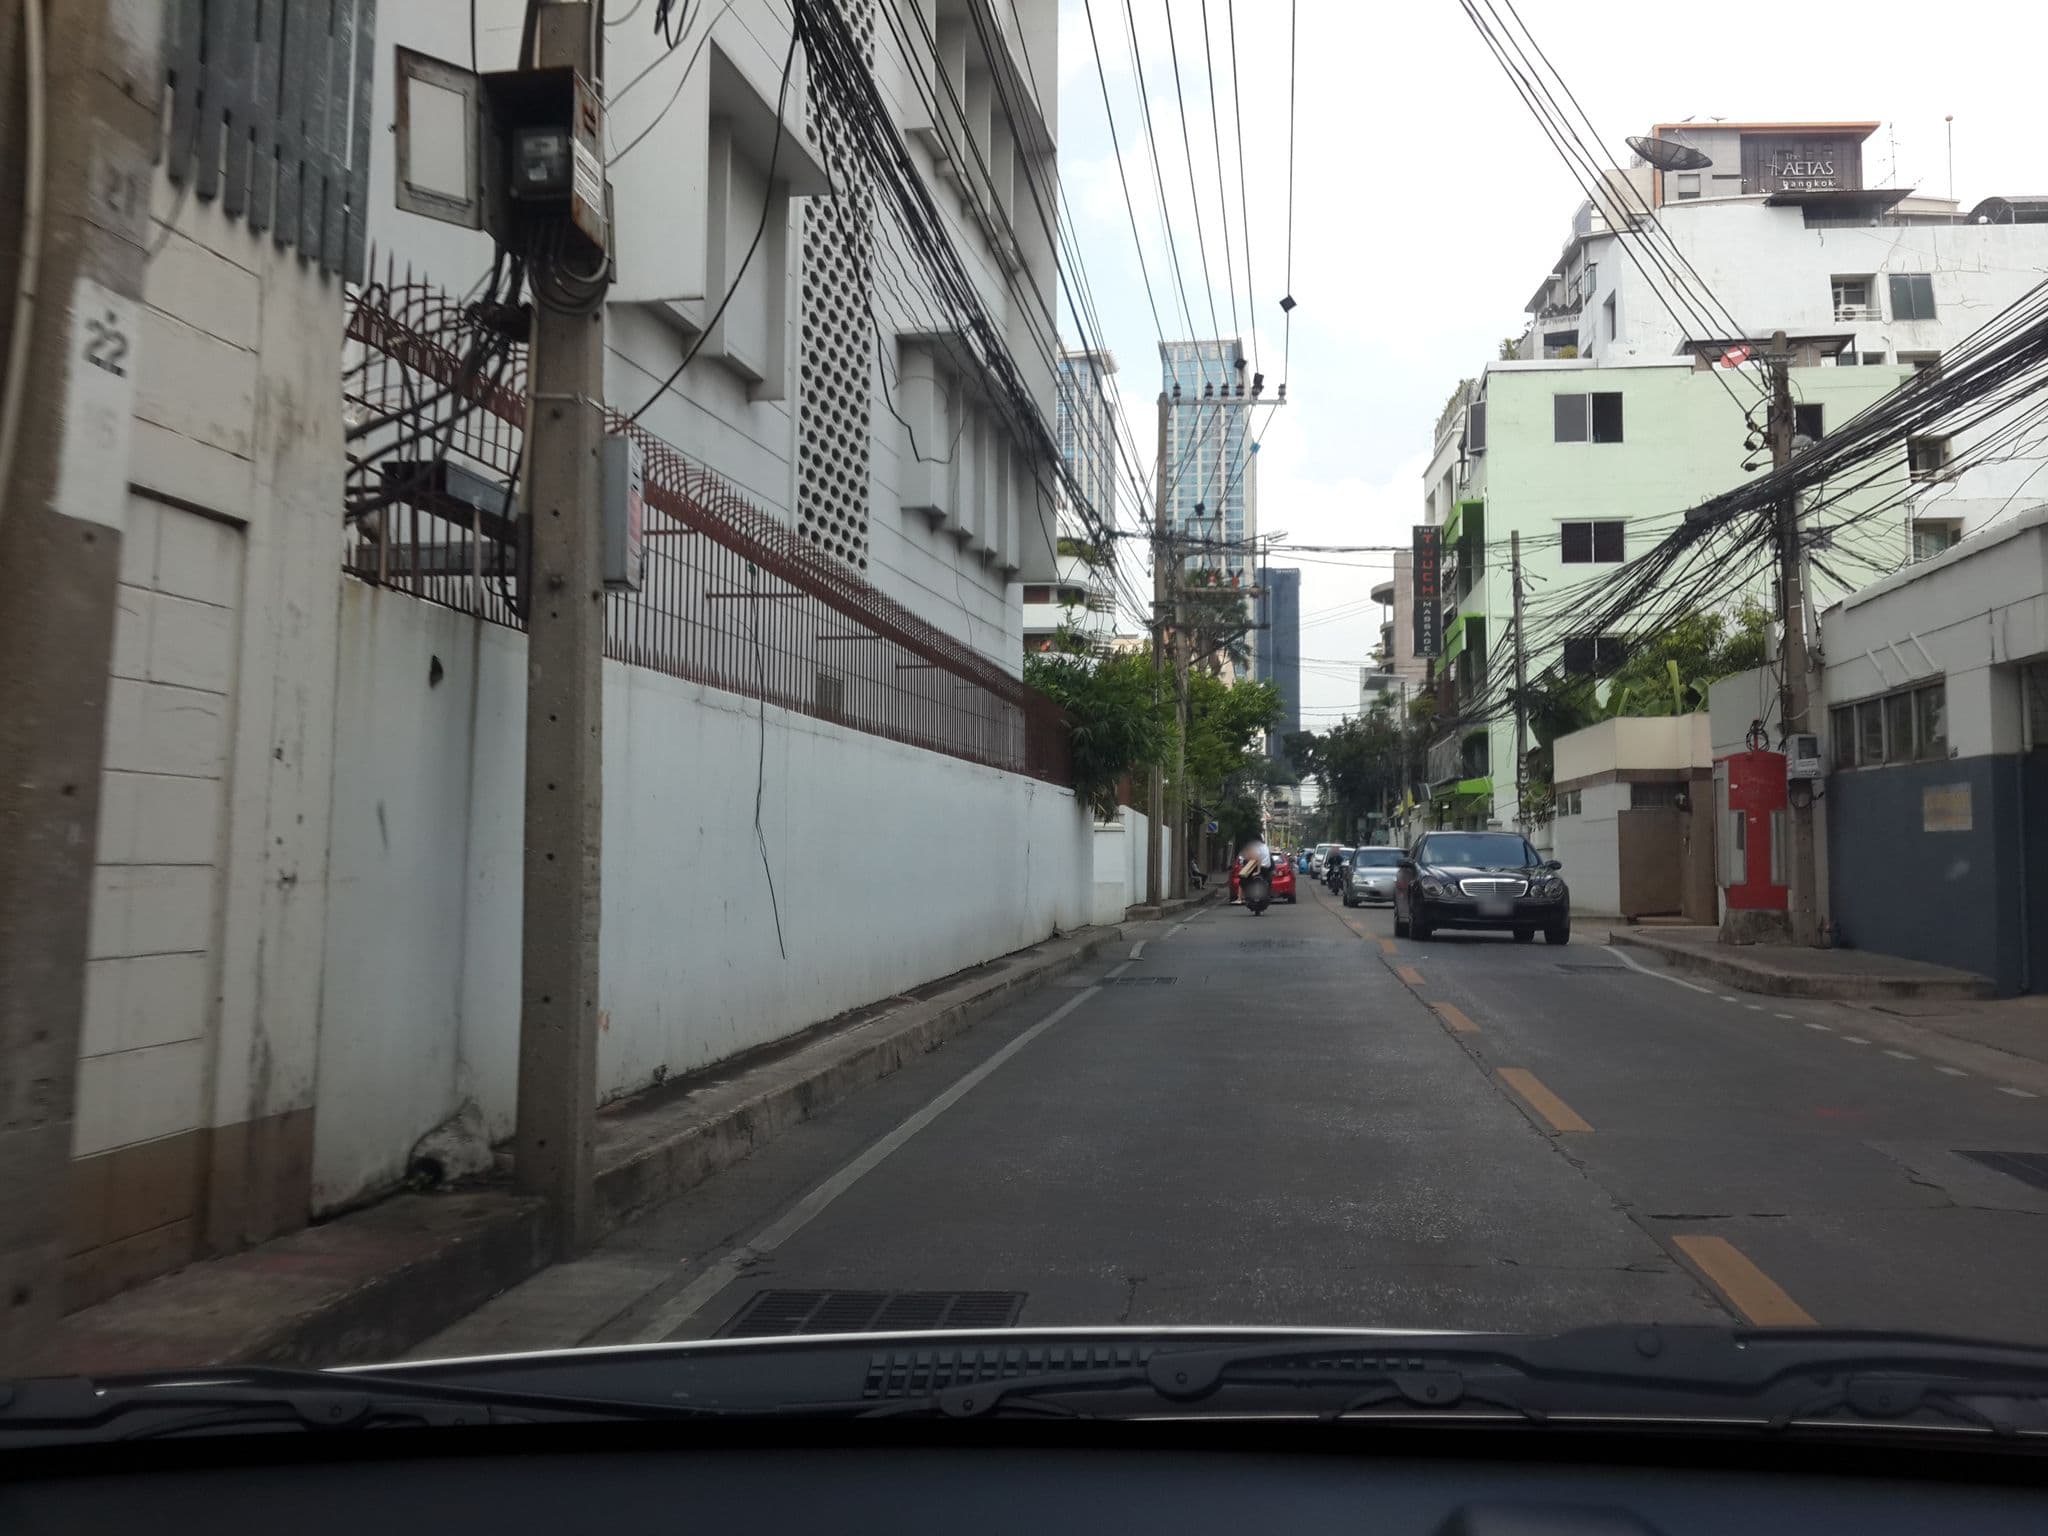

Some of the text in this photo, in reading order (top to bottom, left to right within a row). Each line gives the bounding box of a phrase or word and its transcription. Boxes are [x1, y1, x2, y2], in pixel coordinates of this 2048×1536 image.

[1782, 161, 1834, 176] AETAS
[1782, 180, 1835, 189] bangkok
[84, 318, 128, 378] 22
[1423, 601, 1432, 652] MASSAGE
